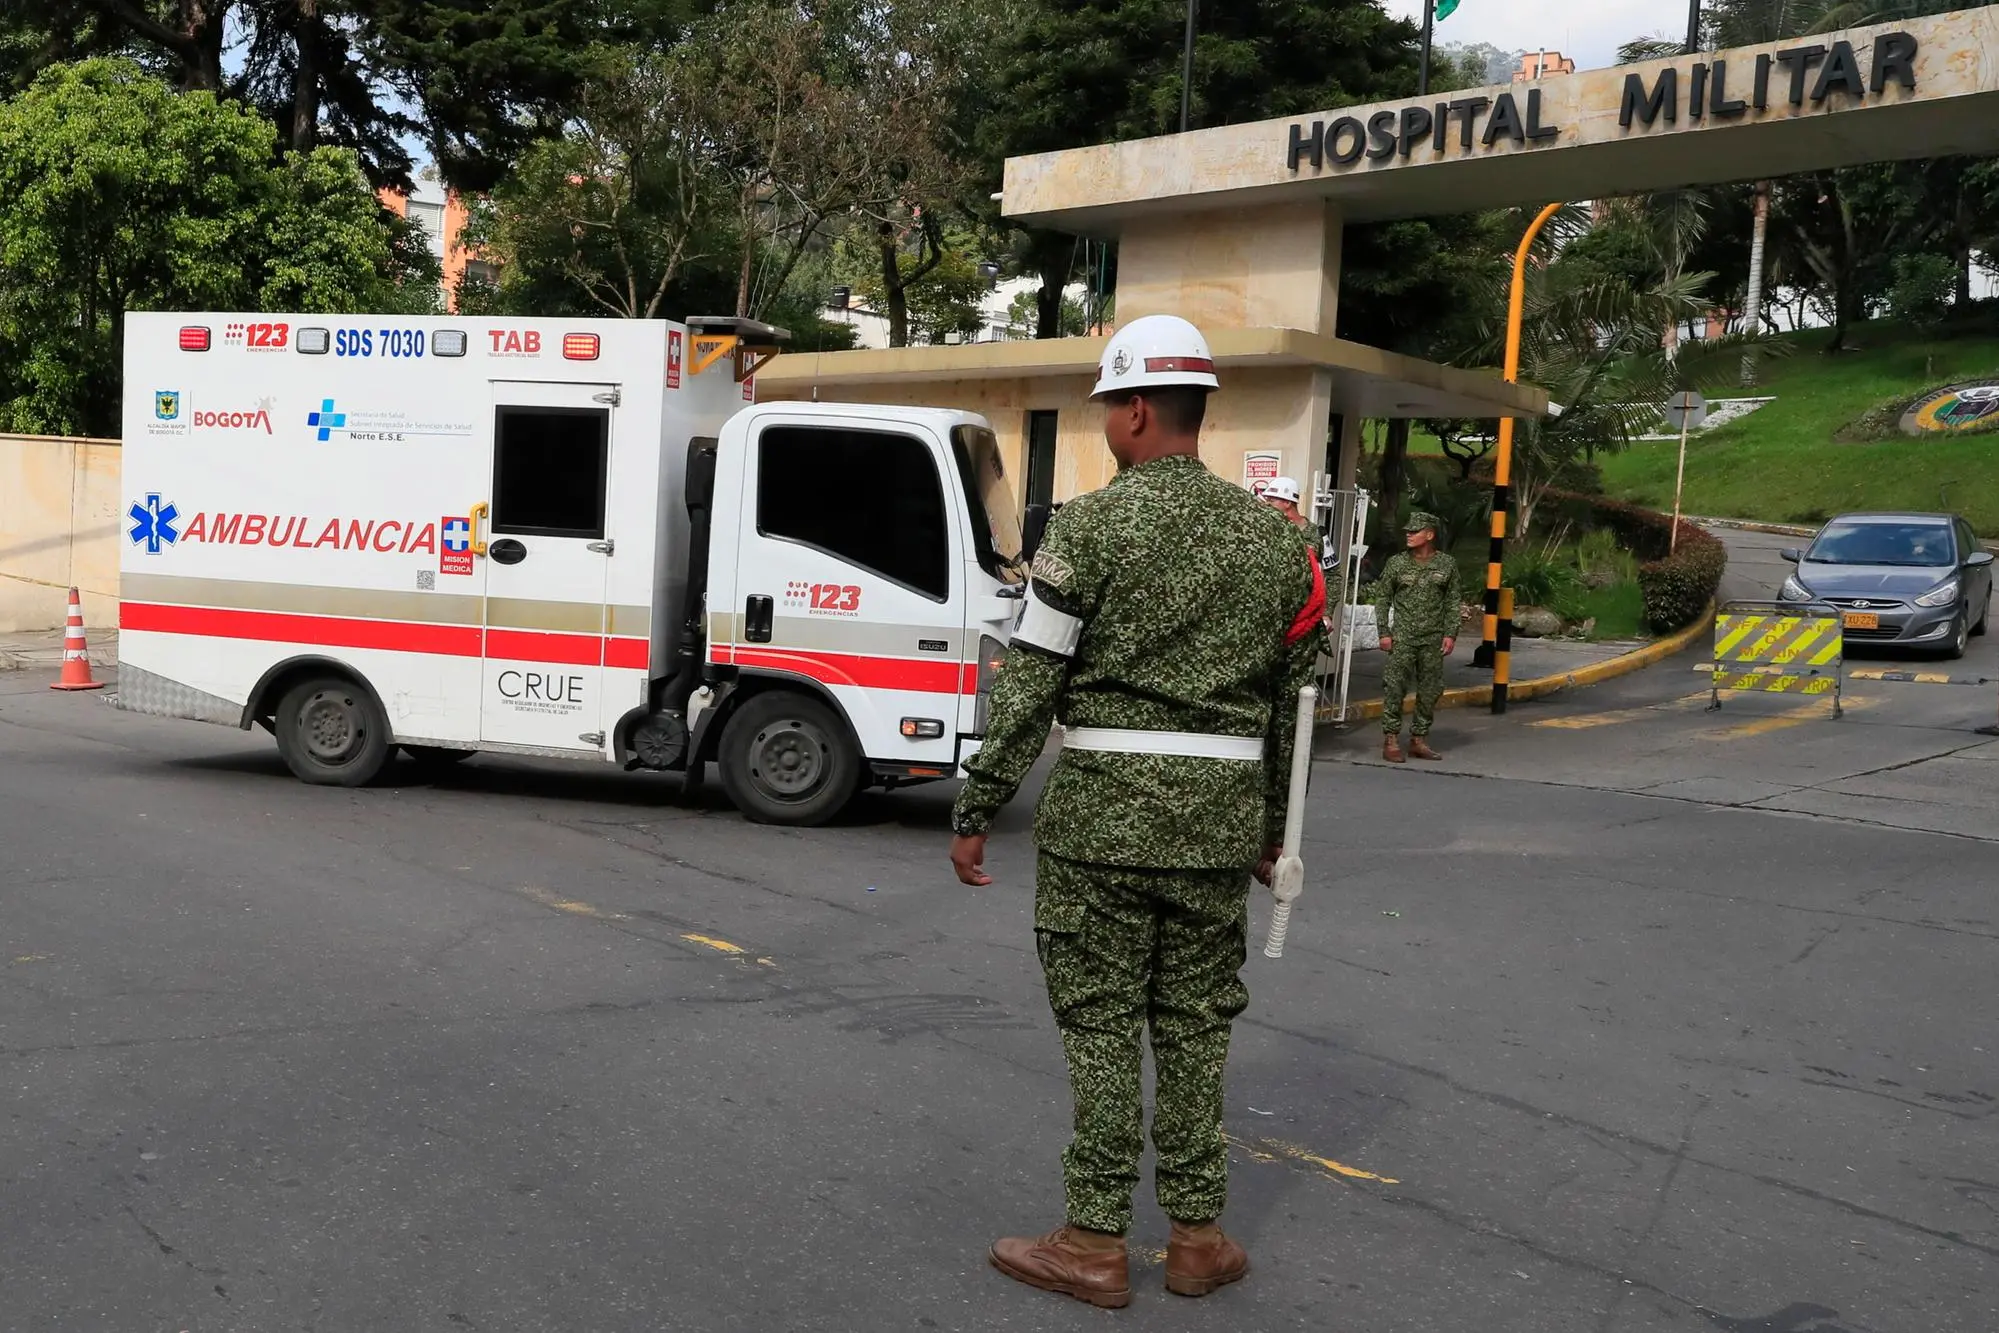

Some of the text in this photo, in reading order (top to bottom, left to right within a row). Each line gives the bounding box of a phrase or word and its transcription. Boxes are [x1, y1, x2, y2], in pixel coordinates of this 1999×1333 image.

[1287, 31, 1918, 170] HOSPITAL MILITAR
[247, 323, 289, 347] 123
[335, 328, 425, 358] SDS 7030
[488, 330, 541, 352] TAB
[350, 432, 376, 441] Norte
[181, 511, 436, 555] AMBULANCIA
[809, 583, 862, 611] 123
[498, 670, 583, 703] CRUE
